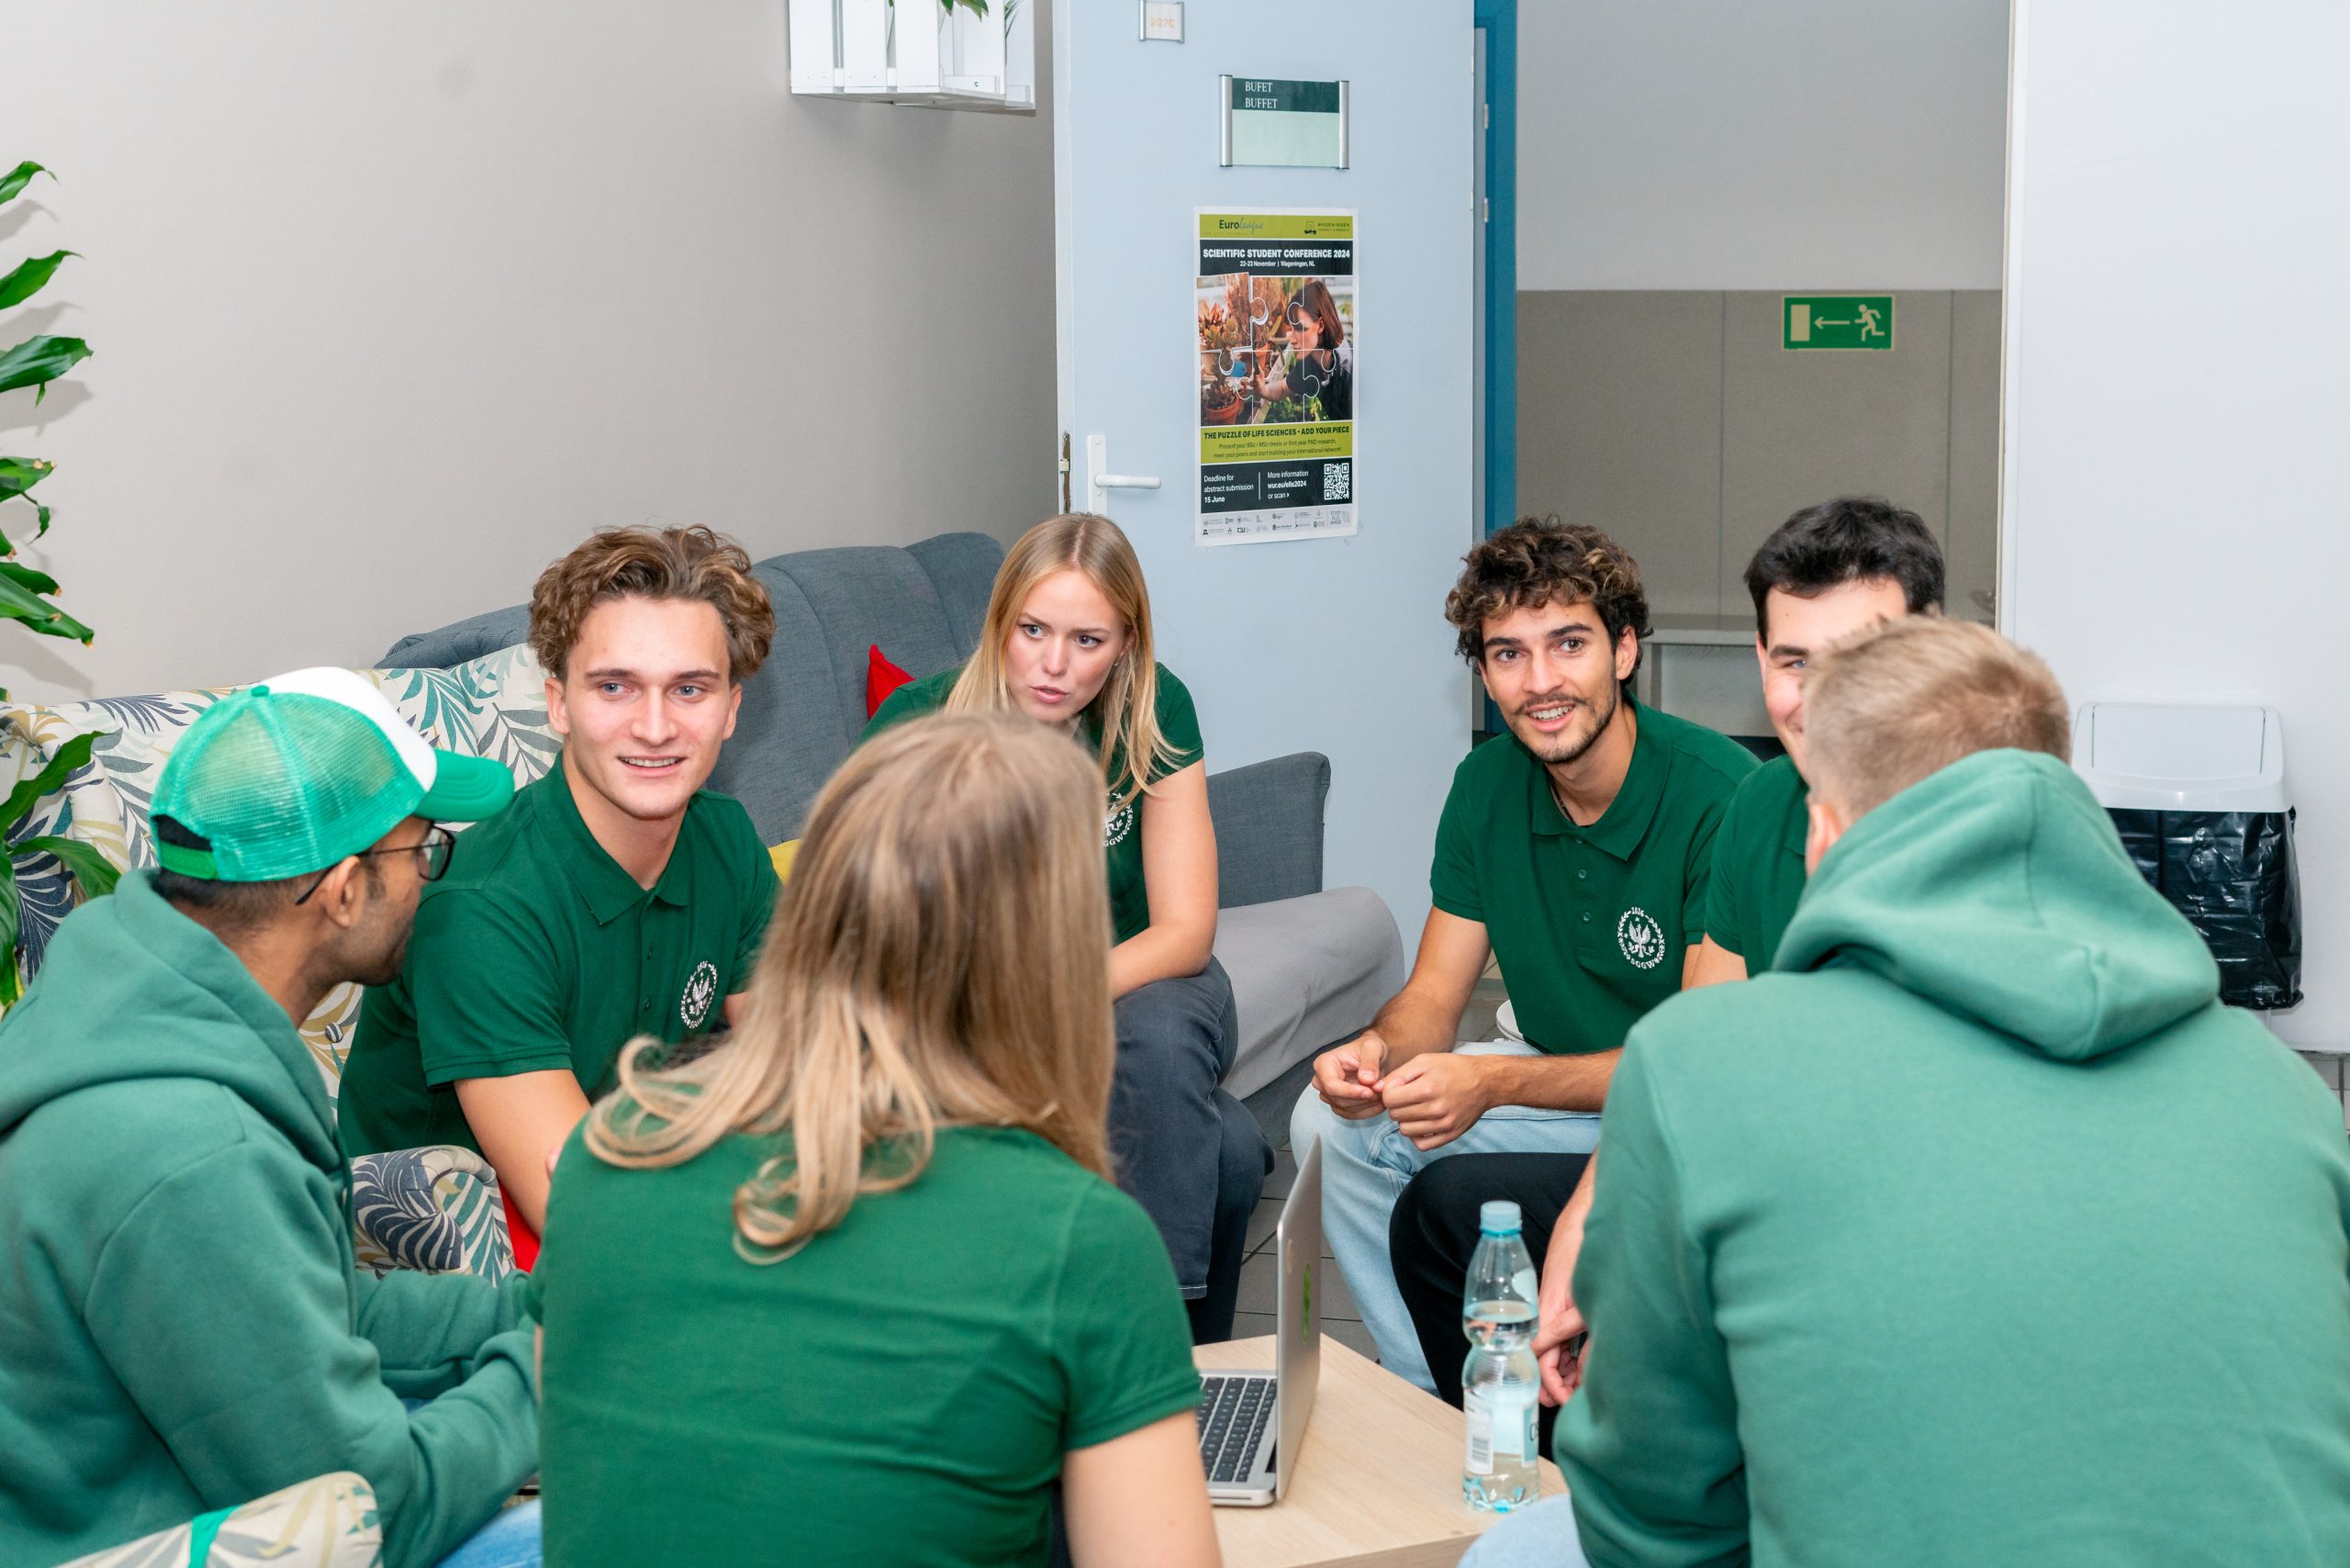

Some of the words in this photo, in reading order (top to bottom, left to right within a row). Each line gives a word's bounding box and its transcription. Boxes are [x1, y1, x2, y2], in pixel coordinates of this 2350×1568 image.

[1245, 81, 1272, 93] BUFET
[1245, 97, 1278, 109] BUFFET
[1203, 249, 1246, 258] SCIENTIFIC
[1247, 249, 1282, 258] STUDENT
[1283, 249, 1333, 258] CONFERENCE
[1333, 249, 1350, 258] 2024
[1265, 429, 1297, 437] SCIENCES
[1281, 470, 1309, 478] information
[1203, 475, 1226, 483] Deadline
[1203, 485, 1225, 493] abstract
[1225, 484, 1254, 492] submission
[1630, 958, 1656, 969] SGGW
